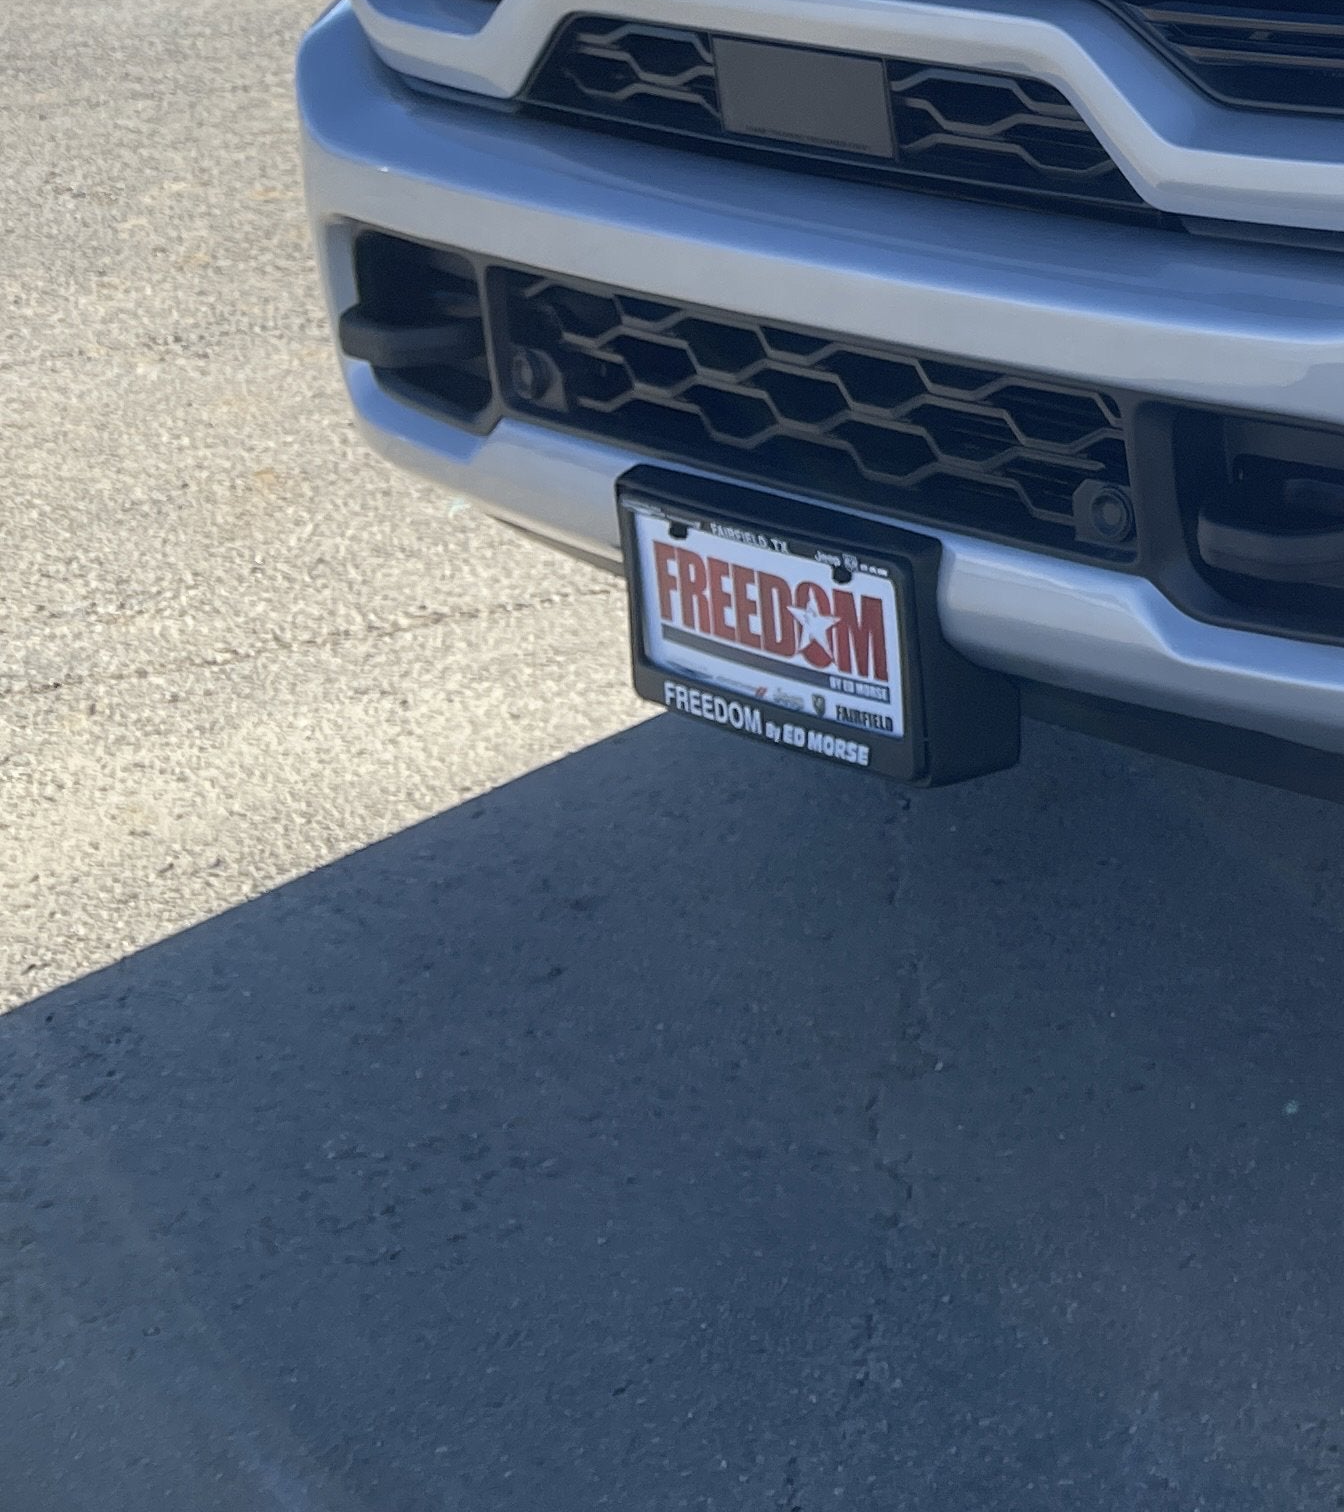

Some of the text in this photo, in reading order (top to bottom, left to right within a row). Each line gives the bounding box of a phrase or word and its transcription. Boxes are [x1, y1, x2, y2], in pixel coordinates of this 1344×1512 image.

[653, 540, 889, 682] FREEDOM
[664, 680, 762, 736] FREEDOM
[783, 723, 806, 748] ED
[807, 730, 869, 767] MORSE
